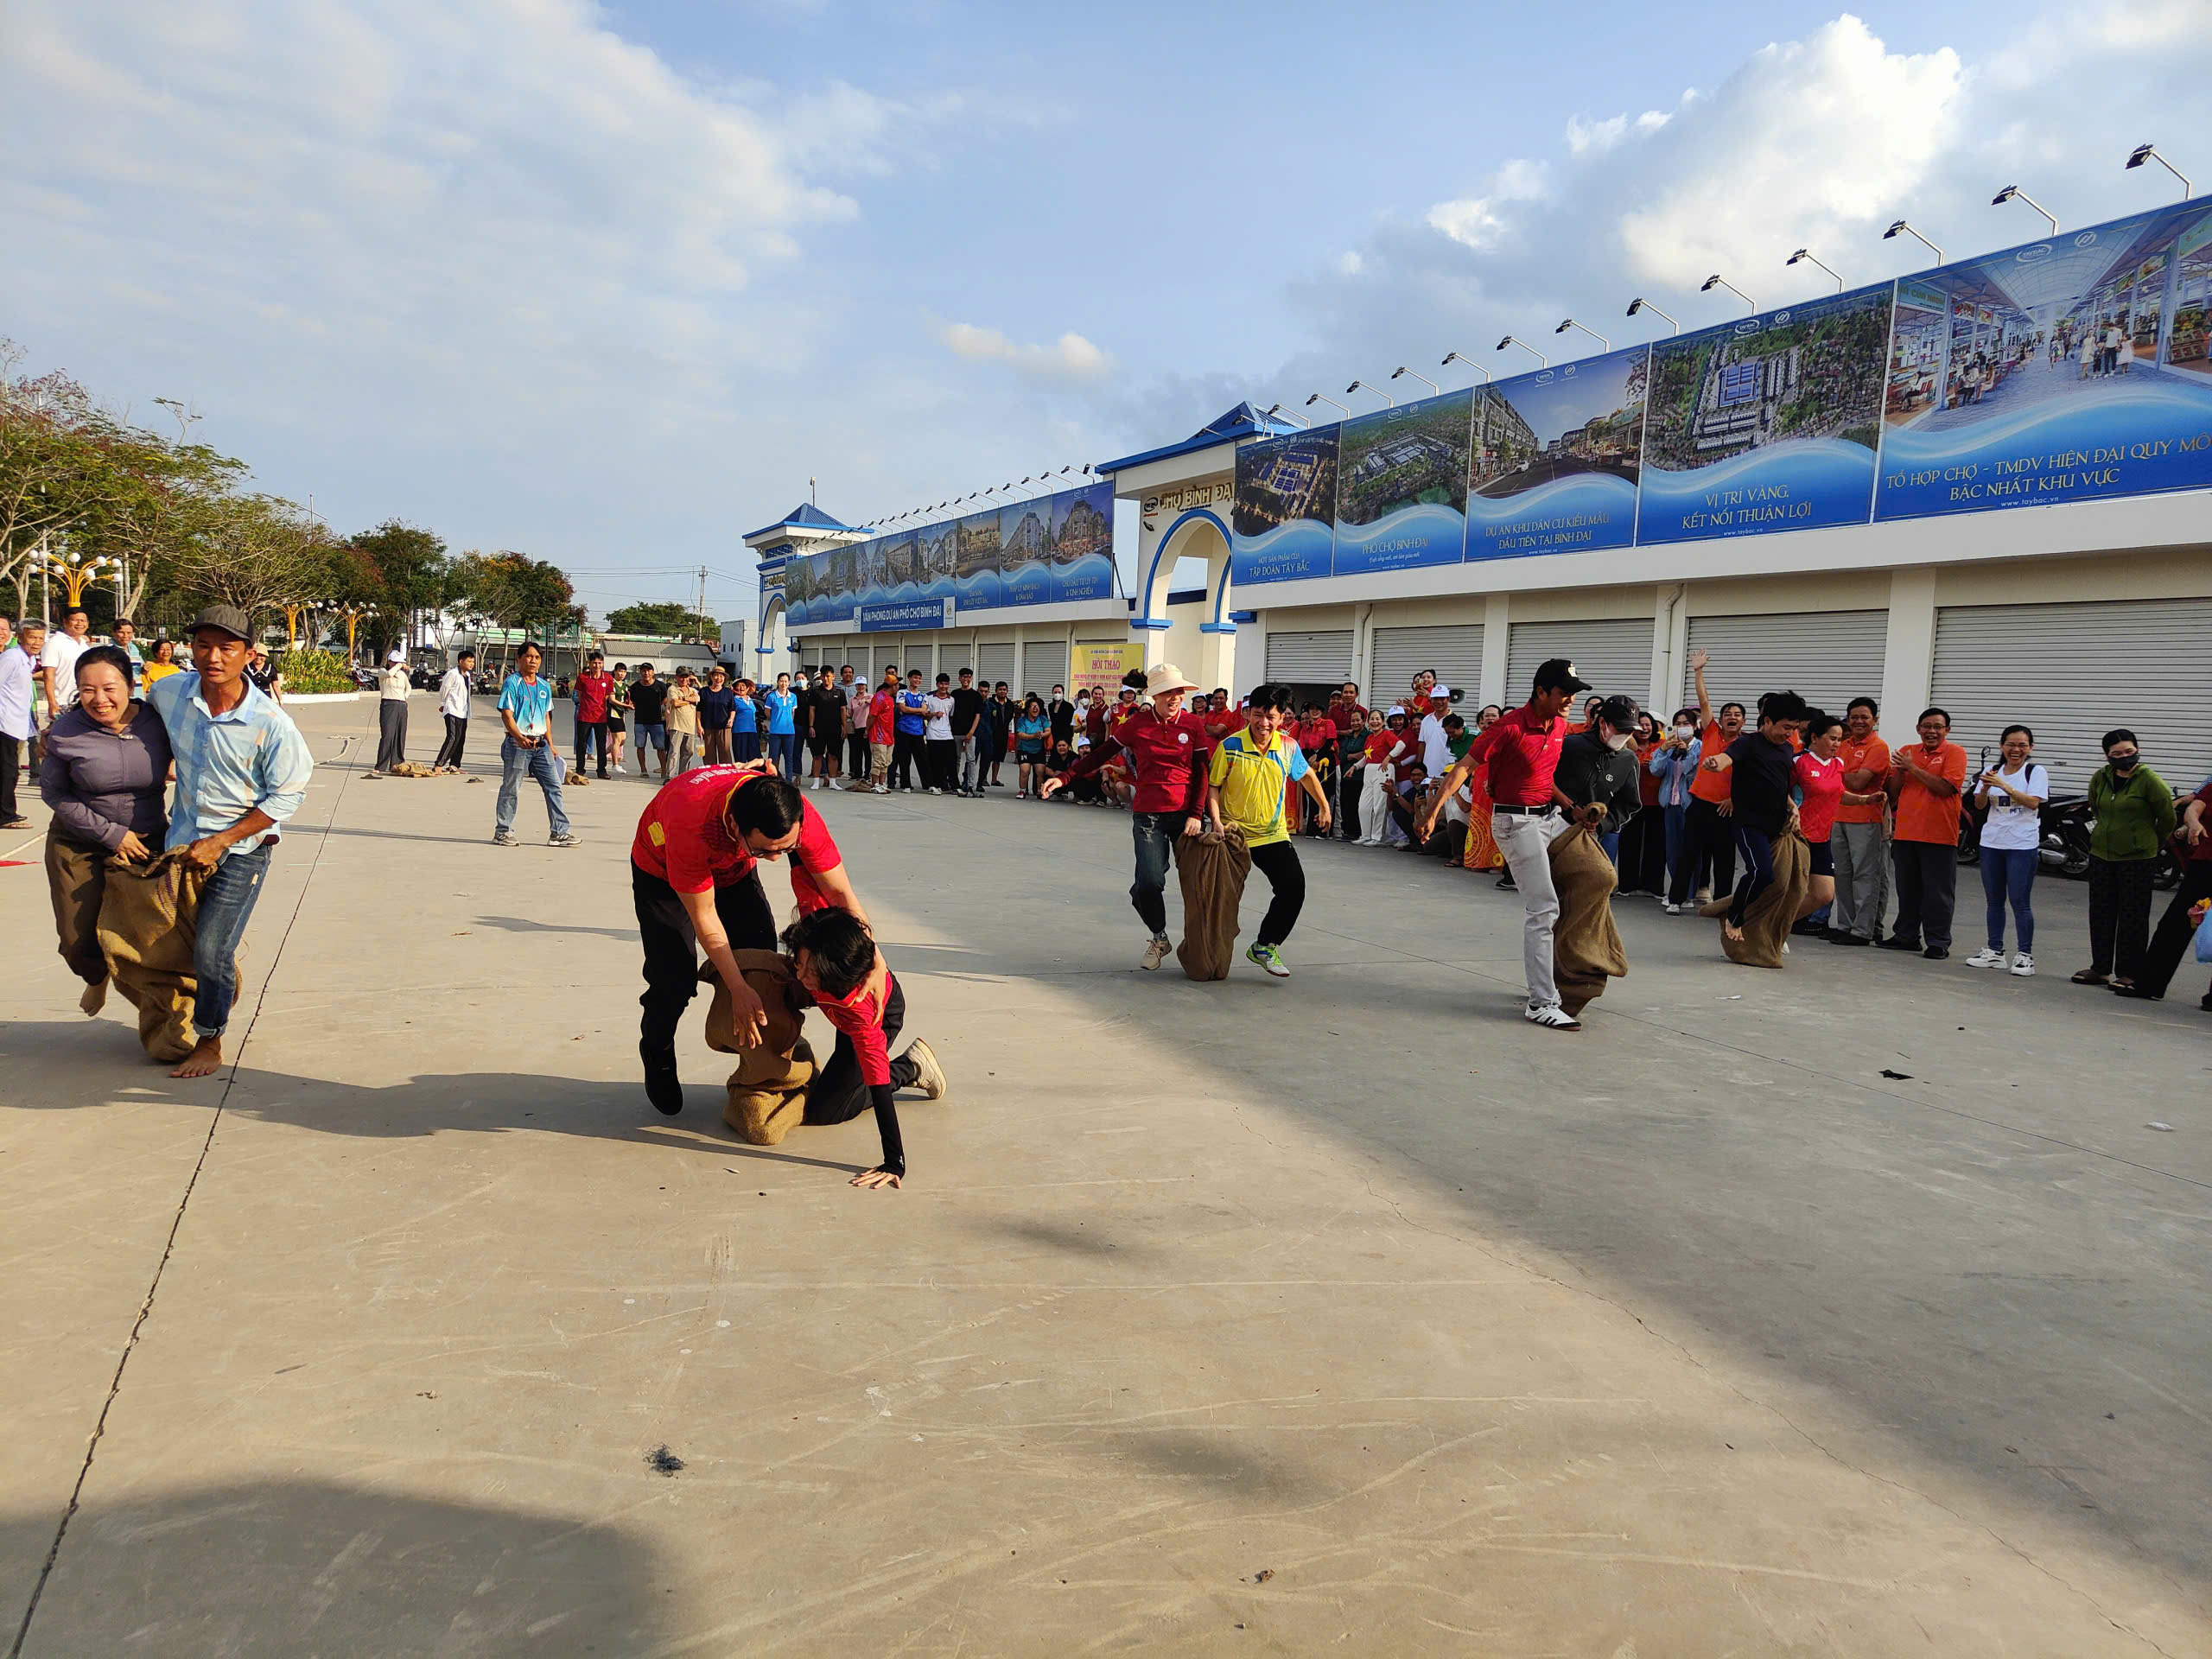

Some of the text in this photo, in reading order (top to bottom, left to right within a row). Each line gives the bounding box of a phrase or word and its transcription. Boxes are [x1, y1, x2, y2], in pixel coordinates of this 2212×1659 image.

[1886, 470, 1906, 489] TỔ
[1910, 469, 1941, 487] HỢP
[1944, 463, 1978, 481] CHỢ
[1994, 456, 2044, 475] TMDV
[2049, 449, 2088, 469] HIỆN
[2094, 446, 2126, 464] ĐẠI
[2131, 439, 2174, 460] QUY
[2178, 432, 2212, 453] MÔ
[1185, 485, 1211, 506] BÌNH
[1216, 482, 1234, 502] ĐẠ
[1949, 468, 2120, 502] BẬC NHẤT KHU VỰC
[1706, 493, 1718, 509] VỊ
[1722, 487, 1743, 505] TRÍ
[2000, 496, 2059, 507] www.taybac.vn
[1681, 501, 1812, 529] KẾT NỐI THUẬN LỢI
[1513, 523, 1530, 534] KHU
[1531, 519, 1550, 531] DÂN
[1518, 536, 1536, 548] TIÊN
[1539, 533, 1553, 547] TẠI
[1554, 531, 1574, 543] BÌNH
[1576, 530, 1592, 543] ĐẠI
[909, 607, 920, 620] CHỢ
